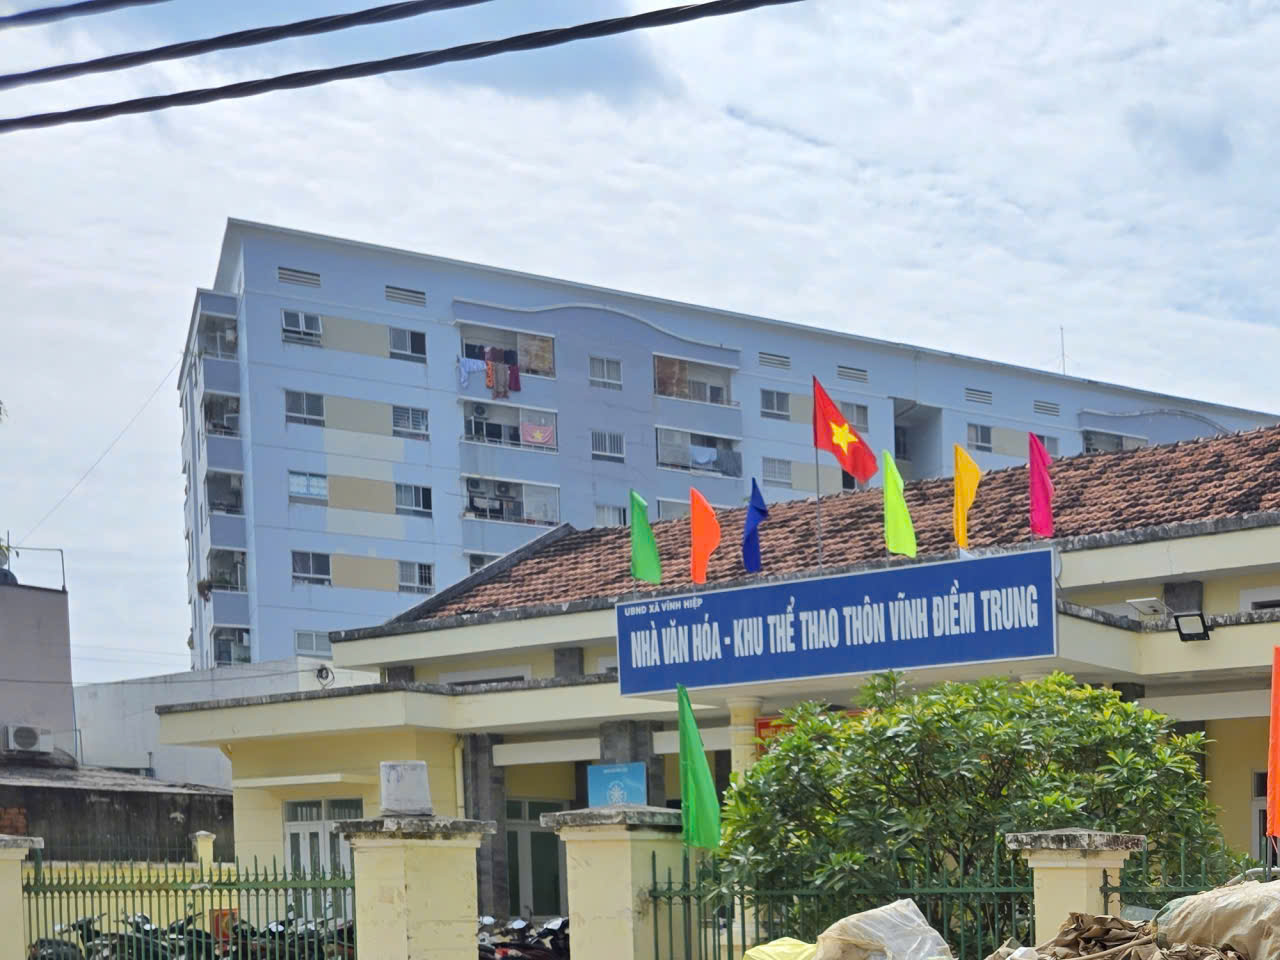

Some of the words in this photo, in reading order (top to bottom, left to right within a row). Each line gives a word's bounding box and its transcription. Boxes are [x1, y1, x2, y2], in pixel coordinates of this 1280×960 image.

[624, 605, 647, 616] UBND
[683, 597, 703, 610] HIỆP
[630, 620, 660, 668] NHÀ
[661, 618, 689, 665] VĂN
[692, 613, 722, 662] HÓA
[733, 616, 764, 657] KHU
[767, 595, 796, 654] THỂ
[799, 607, 840, 650] THAO
[842, 595, 886, 646] THÔN
[888, 591, 929, 641] VĨNH
[932, 579, 976, 637] ĐIỀM
[980, 584, 1039, 632] TRUNG
